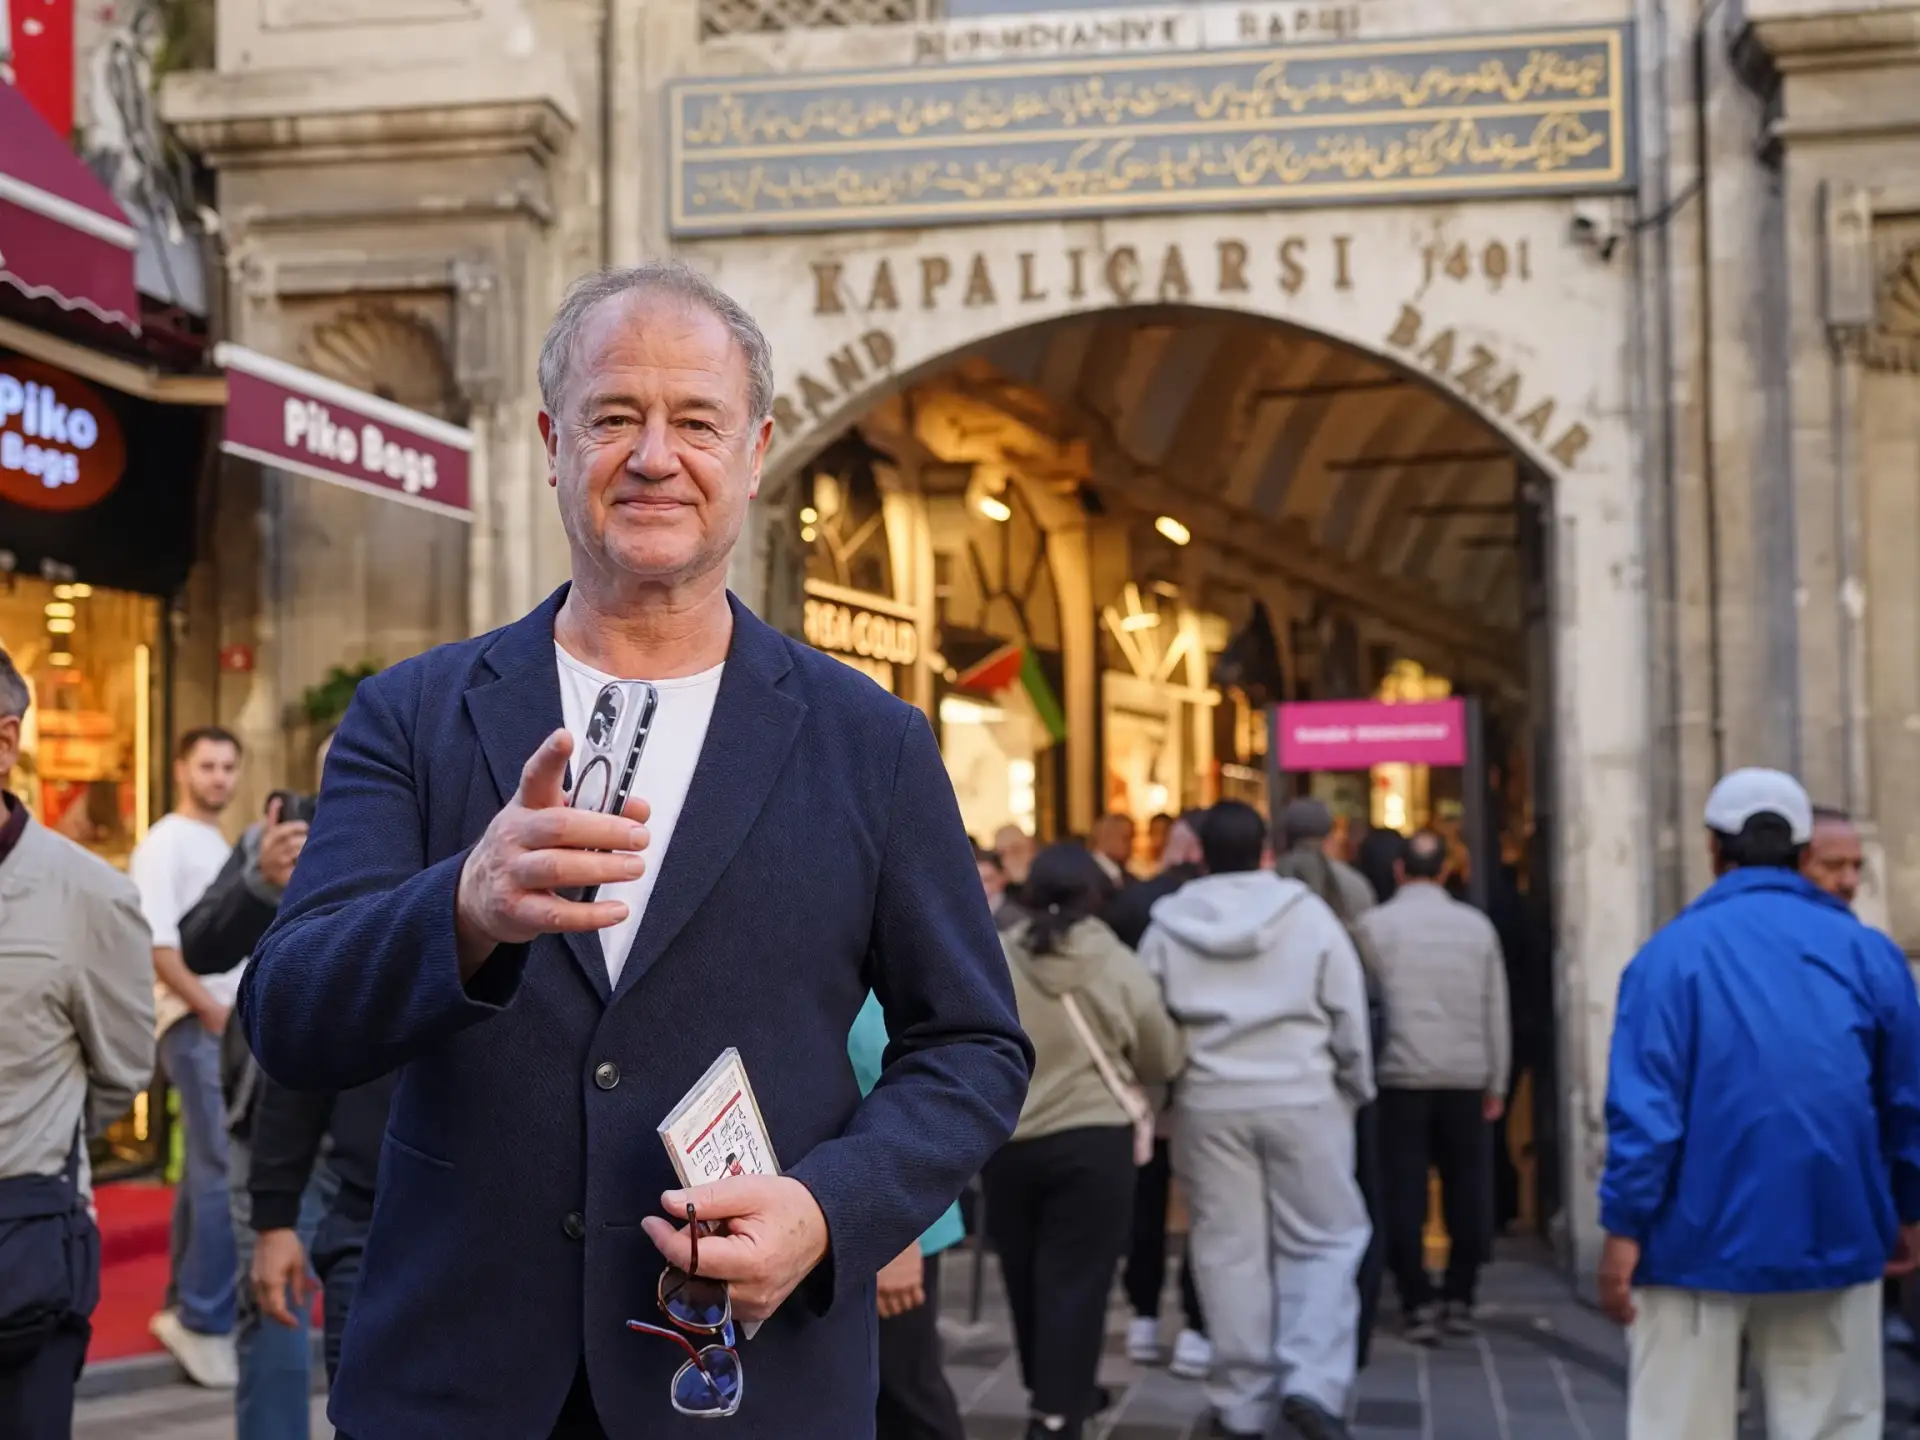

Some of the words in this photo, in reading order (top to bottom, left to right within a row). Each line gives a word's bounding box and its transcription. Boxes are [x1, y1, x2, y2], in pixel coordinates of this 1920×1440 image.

[0, 373, 98, 450] Piko
[768, 328, 897, 446] RAND
[1385, 301, 1592, 471] BAZAAR
[1, 430, 80, 489] Bags
[284, 396, 358, 465] Piko
[361, 424, 438, 494] Bags
